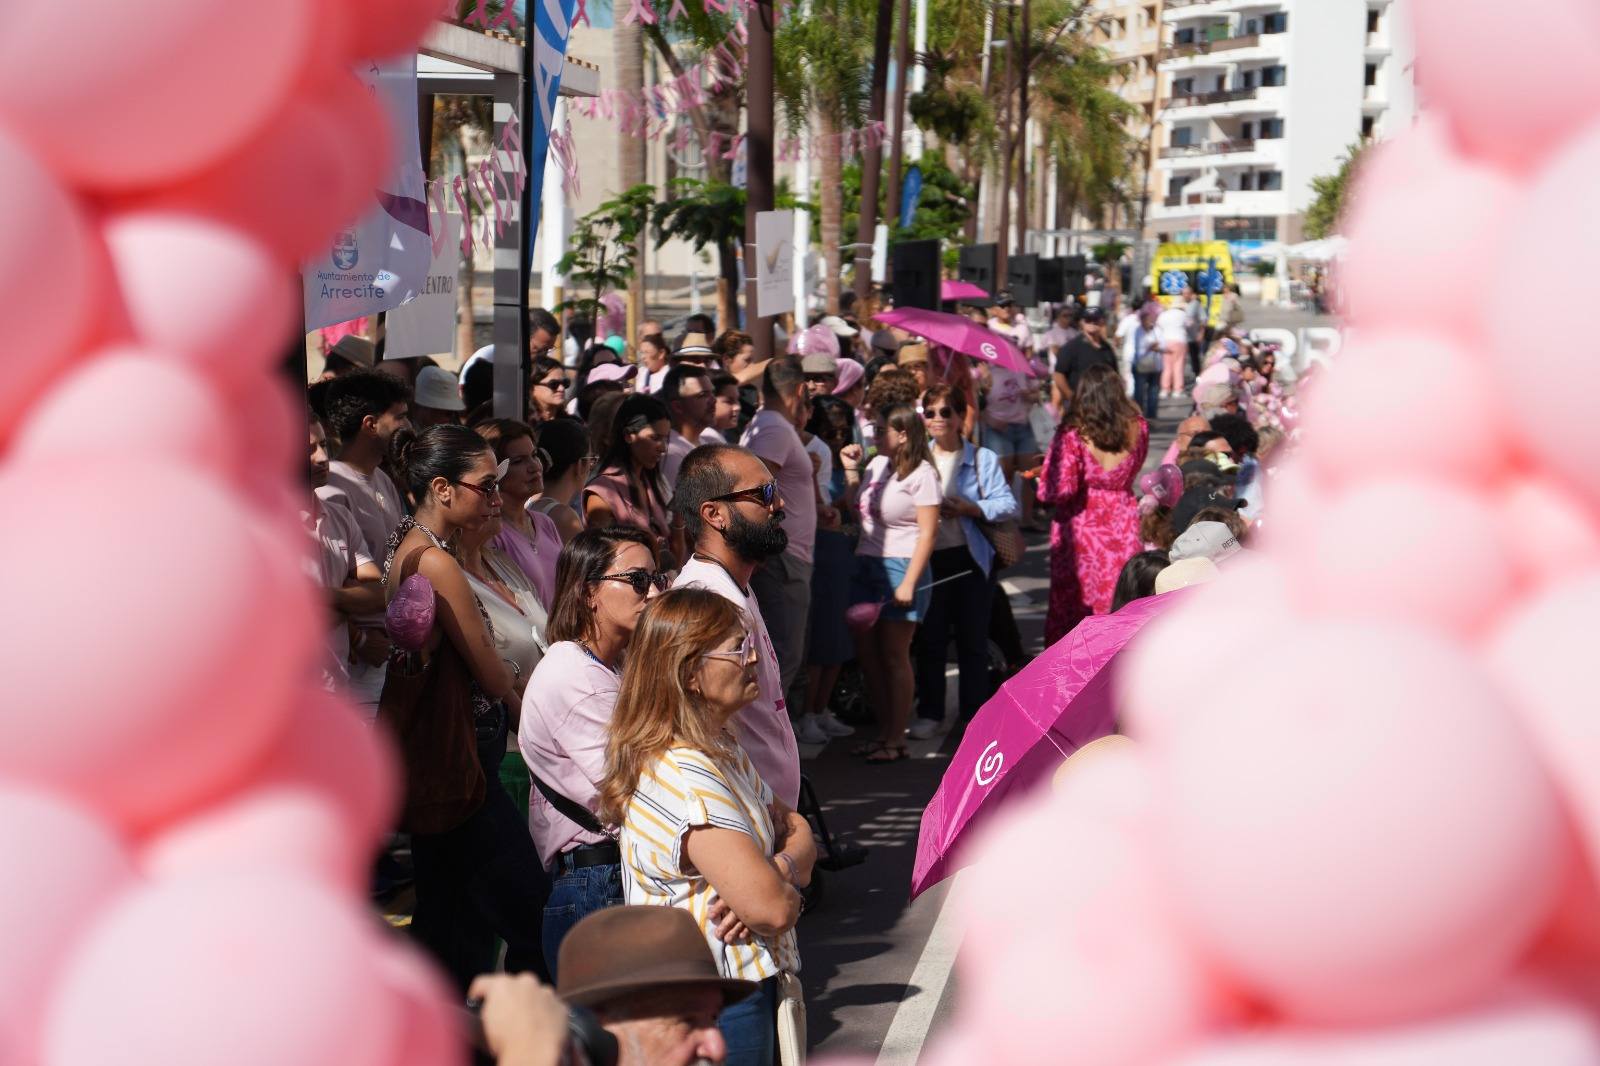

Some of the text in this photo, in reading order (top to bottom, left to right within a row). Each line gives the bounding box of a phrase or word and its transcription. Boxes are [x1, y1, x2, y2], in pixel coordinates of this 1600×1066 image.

[317, 270, 391, 282] Ayuntamiento de
[320, 283, 385, 299] Arrecife
